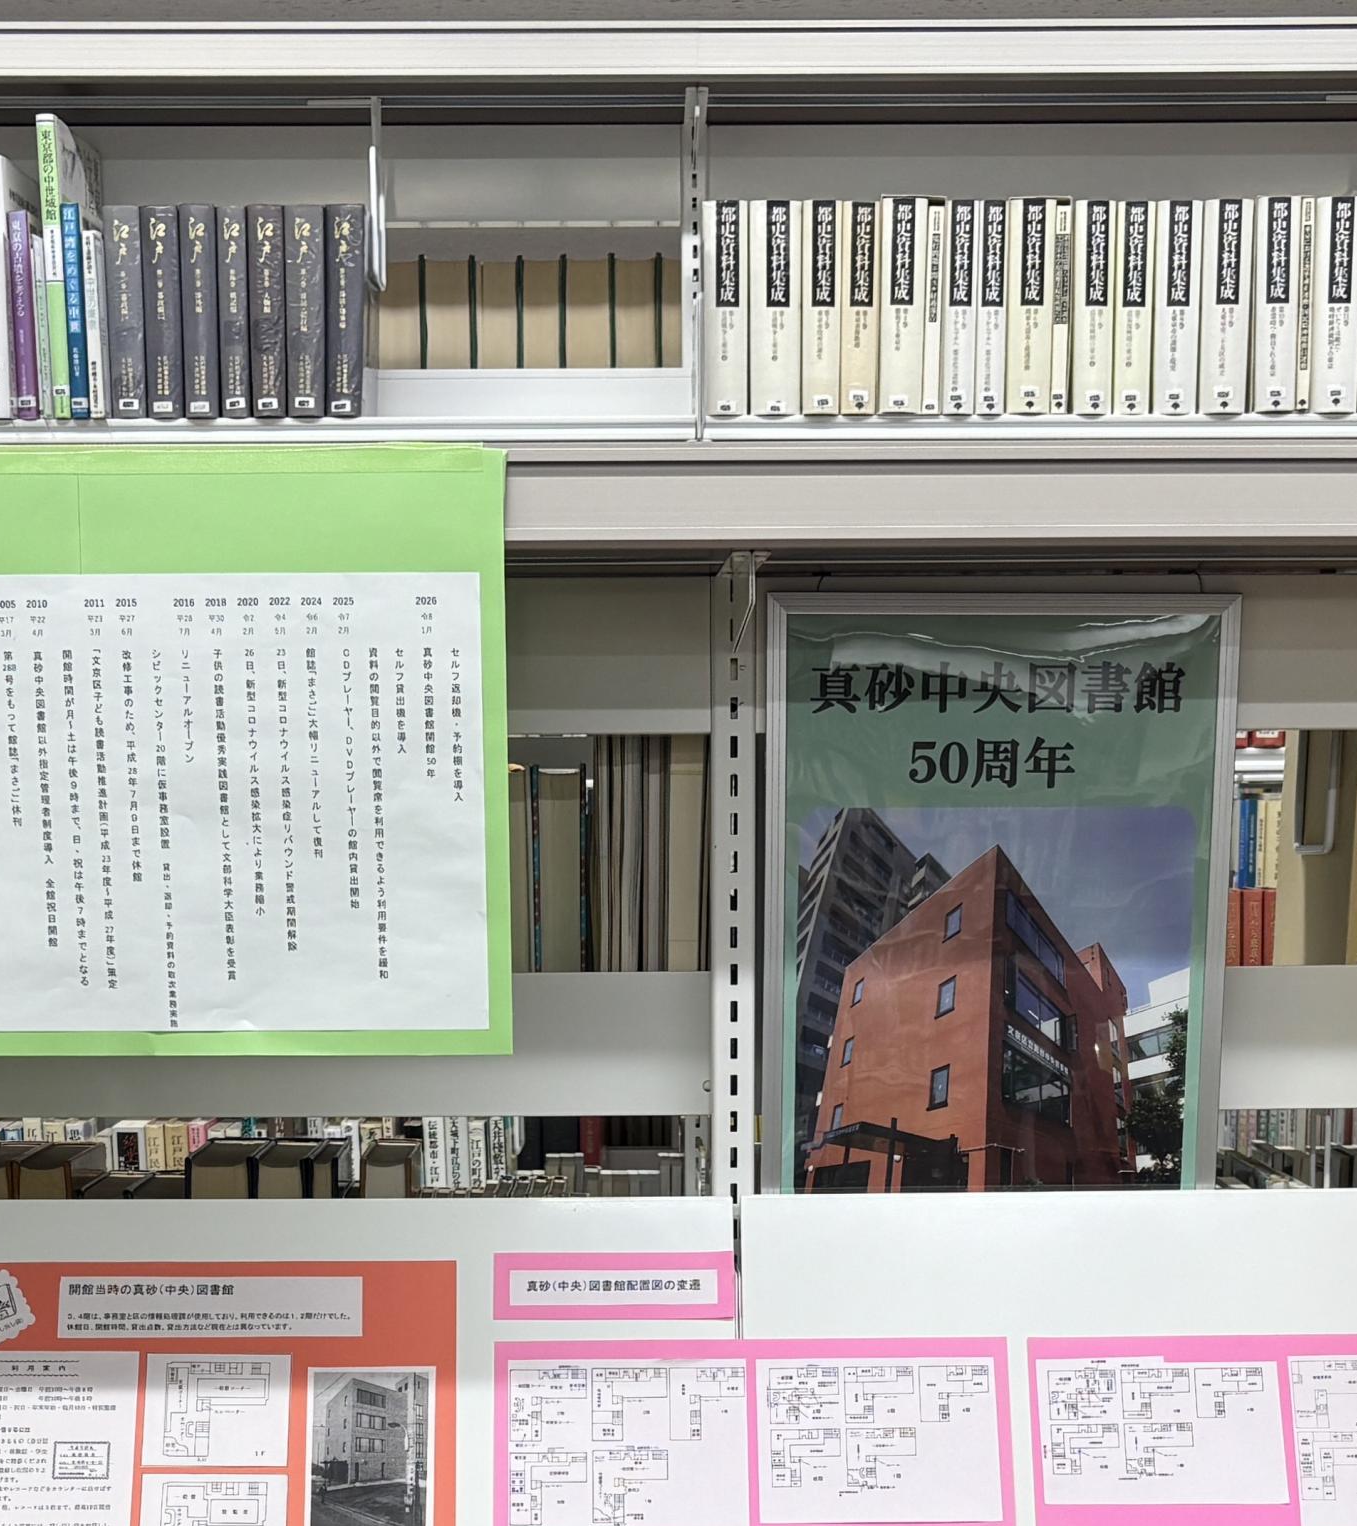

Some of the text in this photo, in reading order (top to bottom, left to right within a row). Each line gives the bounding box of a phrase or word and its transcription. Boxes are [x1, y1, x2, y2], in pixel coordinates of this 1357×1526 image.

[26, 600, 48, 609] 2010
[84, 599, 105, 608] 2011
[115, 599, 137, 608] 2015
[173, 598, 195, 608] 2016
[205, 598, 227, 608] 2018
[237, 597, 259, 606] 2020
[269, 597, 291, 606] 2022
[300, 597, 322, 606] 2024
[332, 597, 354, 606] 2025
[415, 597, 437, 606] 2026
[809, 661, 1187, 716] 真砂中央図書館
[908, 736, 1077, 789] 50周年
